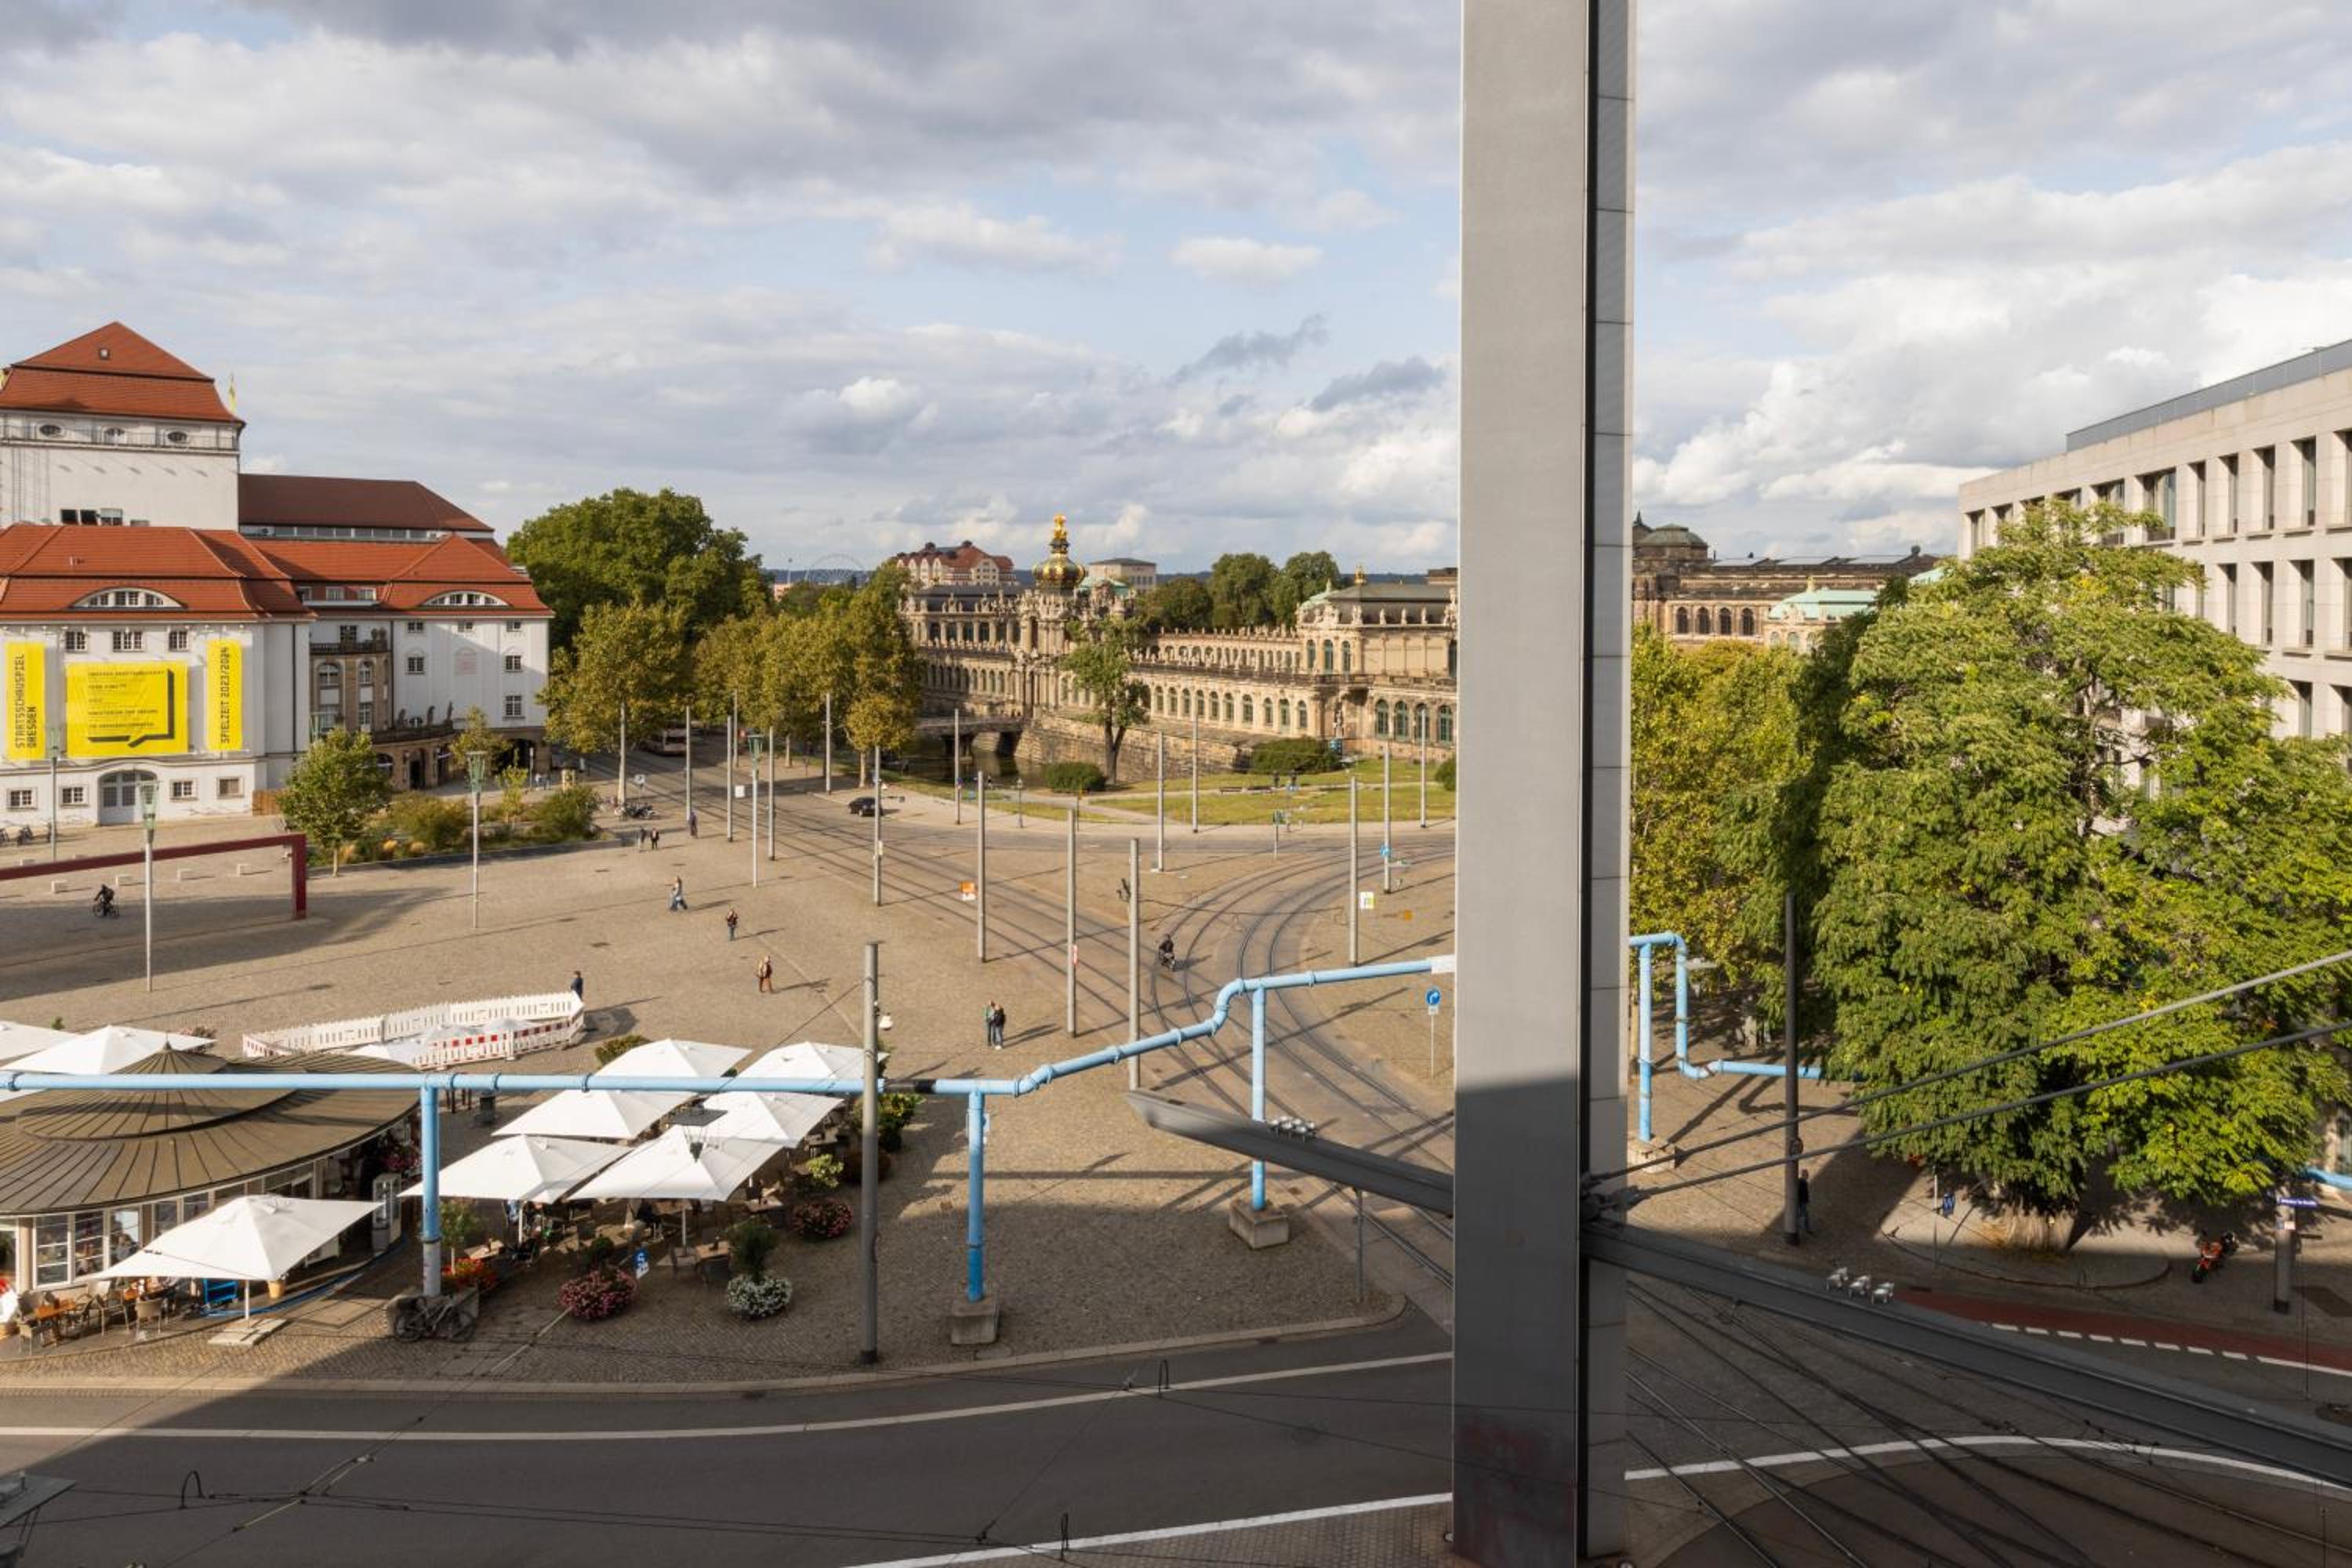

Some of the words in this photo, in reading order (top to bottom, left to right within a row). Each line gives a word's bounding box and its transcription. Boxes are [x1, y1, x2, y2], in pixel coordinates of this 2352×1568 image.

[220, 646, 230, 697] 2023/2024
[15, 653, 25, 749] STAATSSCHAUSPIEL
[220, 701, 230, 744] SPIELZEIT
[26, 706, 36, 749] DRESDEN
